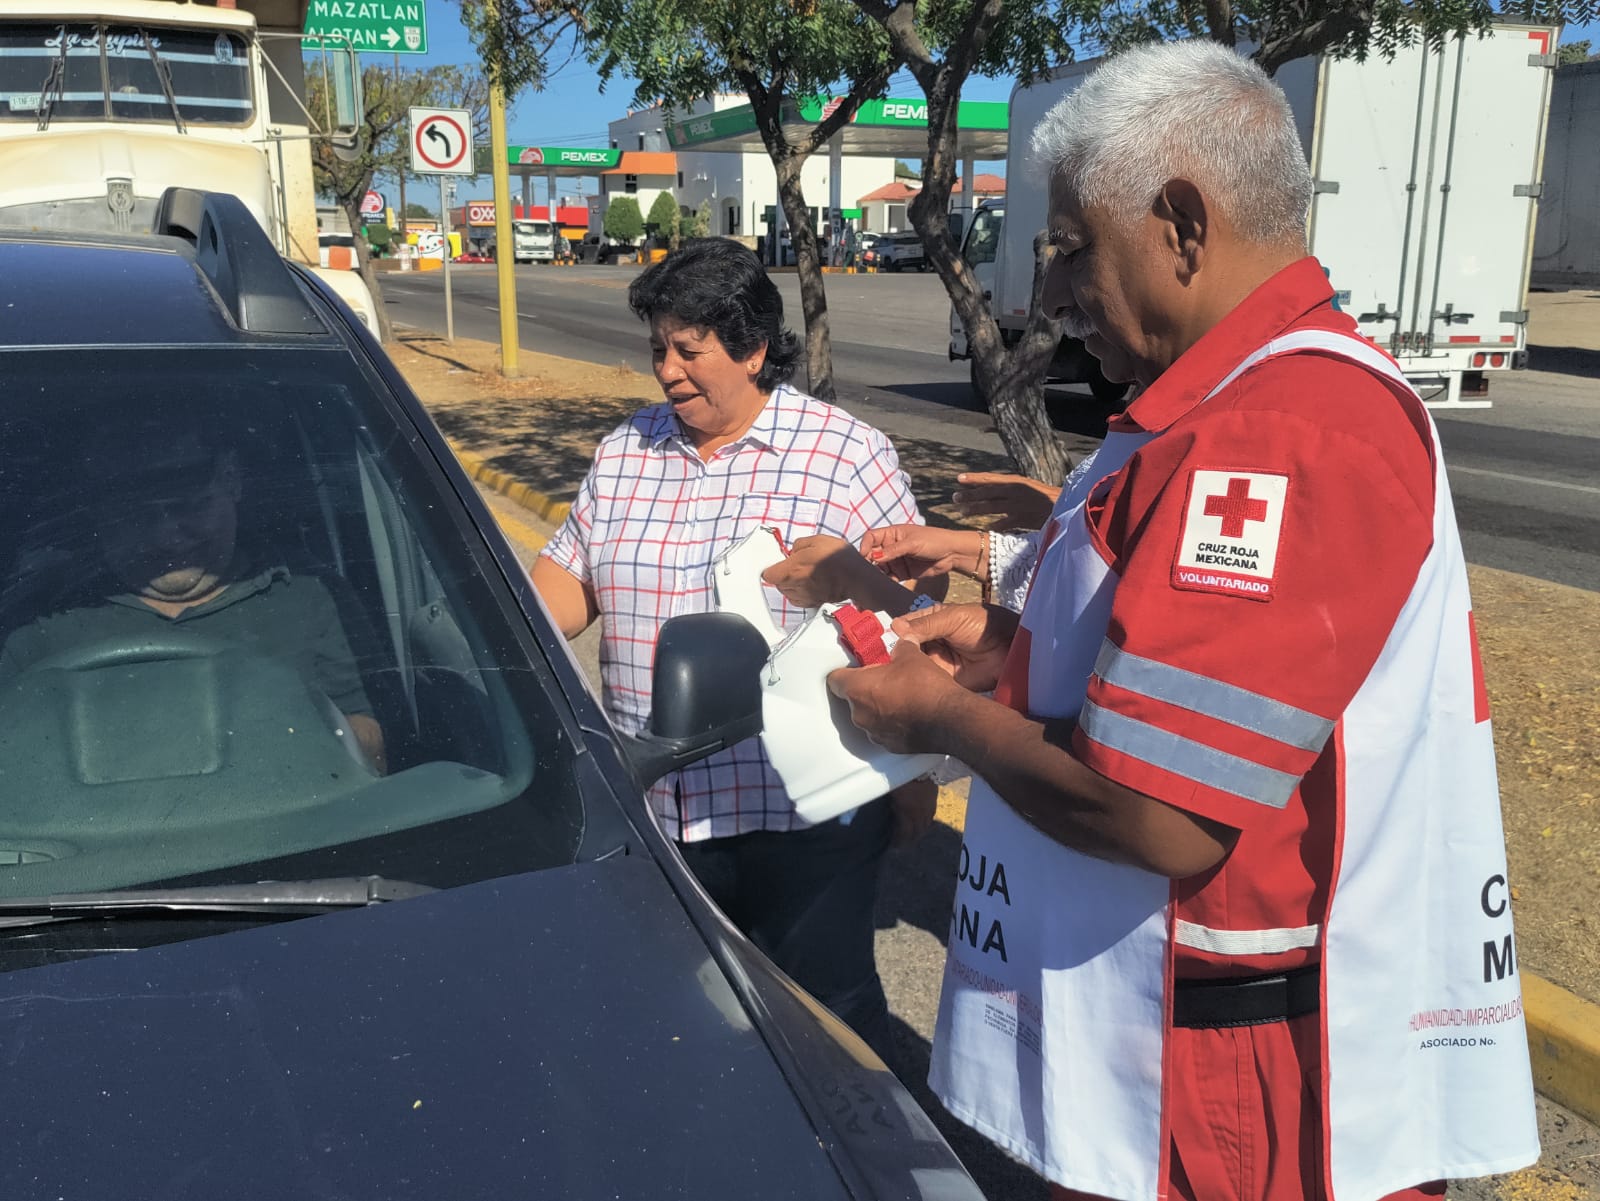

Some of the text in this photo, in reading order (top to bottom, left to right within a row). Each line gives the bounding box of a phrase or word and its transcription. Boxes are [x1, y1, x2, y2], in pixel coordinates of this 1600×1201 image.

[314, 1, 419, 21] MAZATLAN
[81, 24, 162, 54] Lupia
[302, 26, 377, 46] ALOTAN
[882, 103, 929, 120] PEM
[561, 151, 609, 163] PEMEX
[470, 206, 496, 222] OXX
[1198, 542, 1260, 558] CRUZ ROJA
[1195, 553, 1258, 570] MEXICANA
[1179, 572, 1269, 593] VOLUNTARIADO
[957, 843, 1011, 906] OJA
[1480, 873, 1512, 919] C
[1483, 934, 1519, 983] M
[1408, 996, 1522, 1032] HUMANIDAD-IMPARCIALIDA
[1419, 1037, 1497, 1050] ASOCIADO No.
